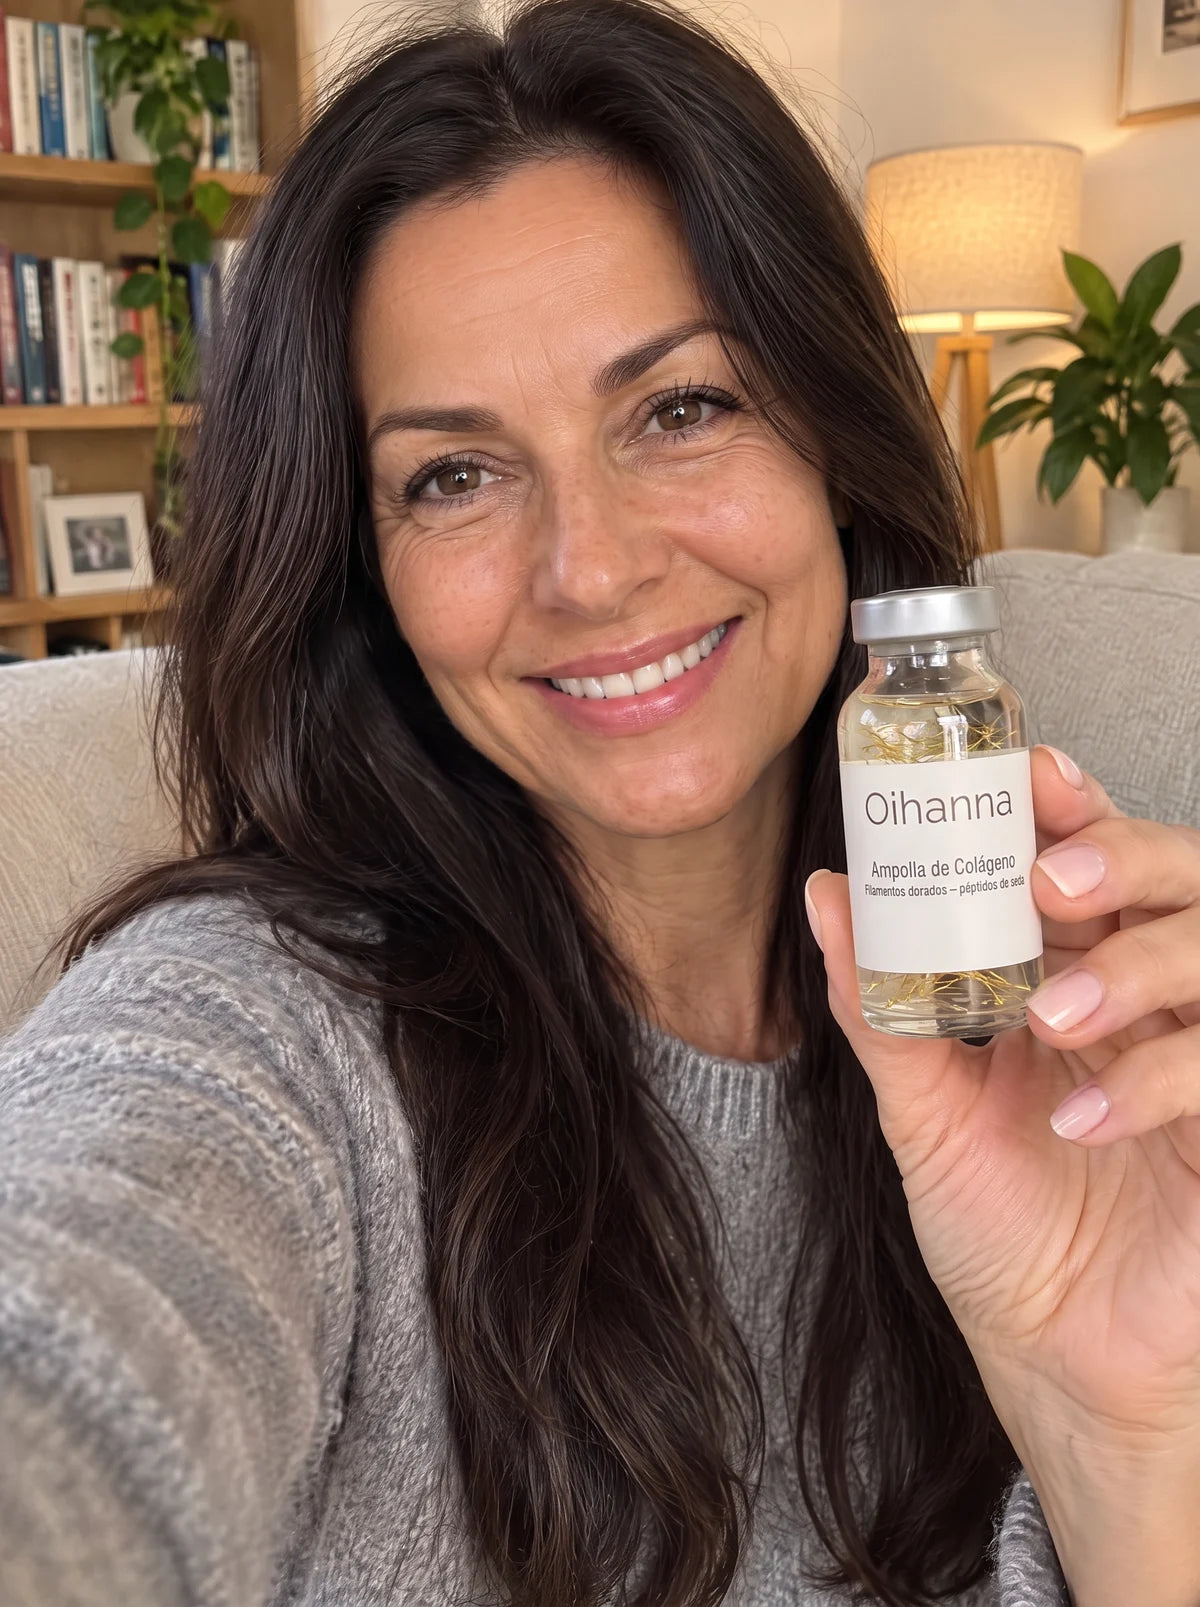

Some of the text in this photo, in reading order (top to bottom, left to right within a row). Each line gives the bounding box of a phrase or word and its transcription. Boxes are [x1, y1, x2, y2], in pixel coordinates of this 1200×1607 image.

[865, 790, 1012, 825] Oihanna
[871, 854, 1016, 882] Ampolla de Colágeno
[864, 884, 906, 897] Filamentos
[908, 884, 948, 897] dorados
[959, 879, 998, 896] péptidos
[999, 877, 1009, 889] de
[1010, 875, 1025, 886] seda
